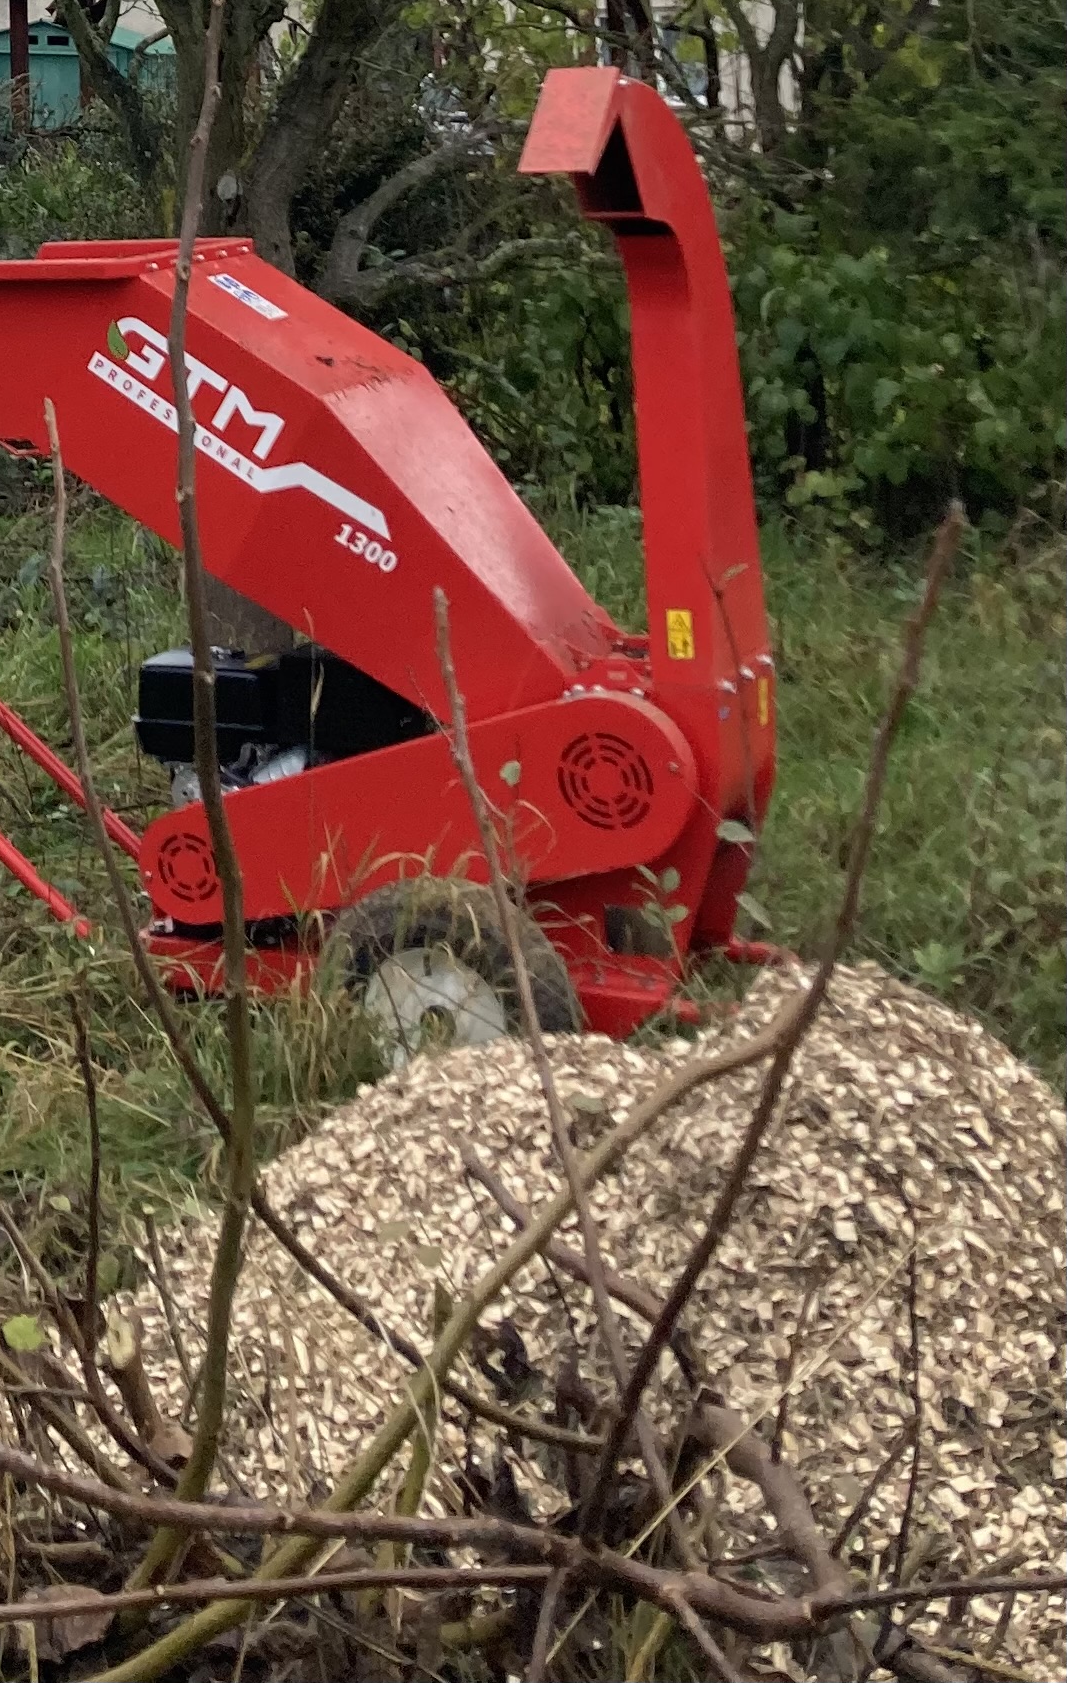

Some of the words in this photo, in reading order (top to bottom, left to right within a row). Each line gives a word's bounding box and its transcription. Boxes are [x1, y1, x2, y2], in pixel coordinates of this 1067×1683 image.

[94, 358, 255, 480] PROFESONAL
[108, 316, 285, 460] GTM
[334, 523, 398, 572] 1300
